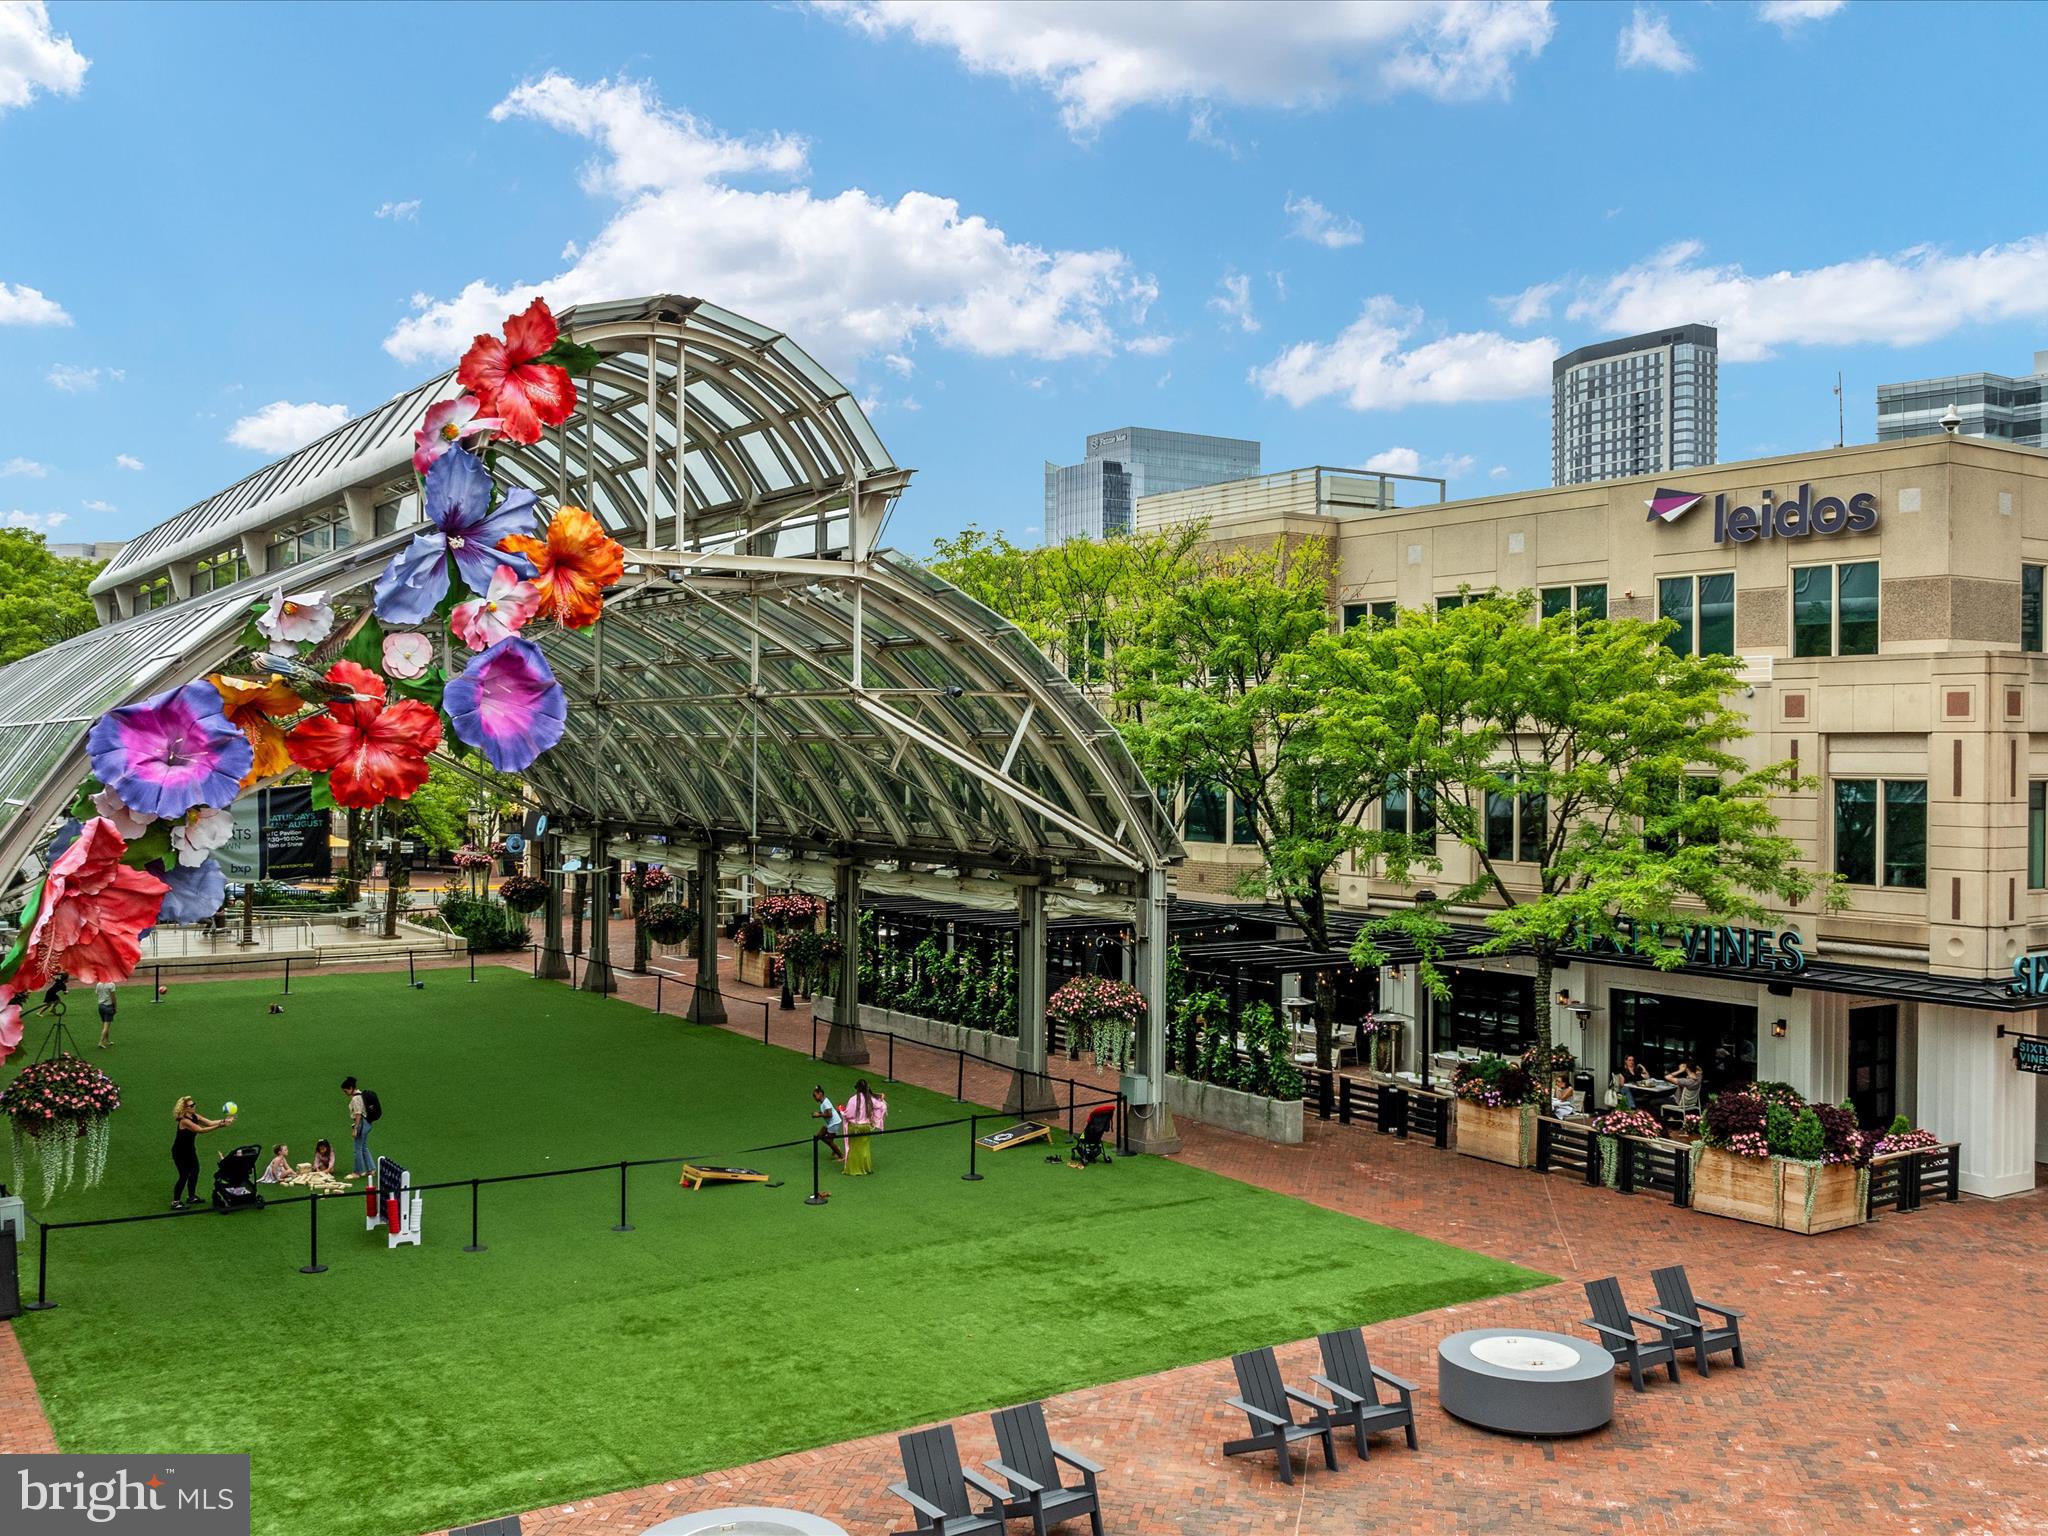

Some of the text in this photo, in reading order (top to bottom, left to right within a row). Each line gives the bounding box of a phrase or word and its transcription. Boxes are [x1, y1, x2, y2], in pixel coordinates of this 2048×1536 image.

[1713, 482, 1880, 544] leidos
[231, 864, 252, 876] bxp
[1560, 909, 1806, 975] SIXT VINES
